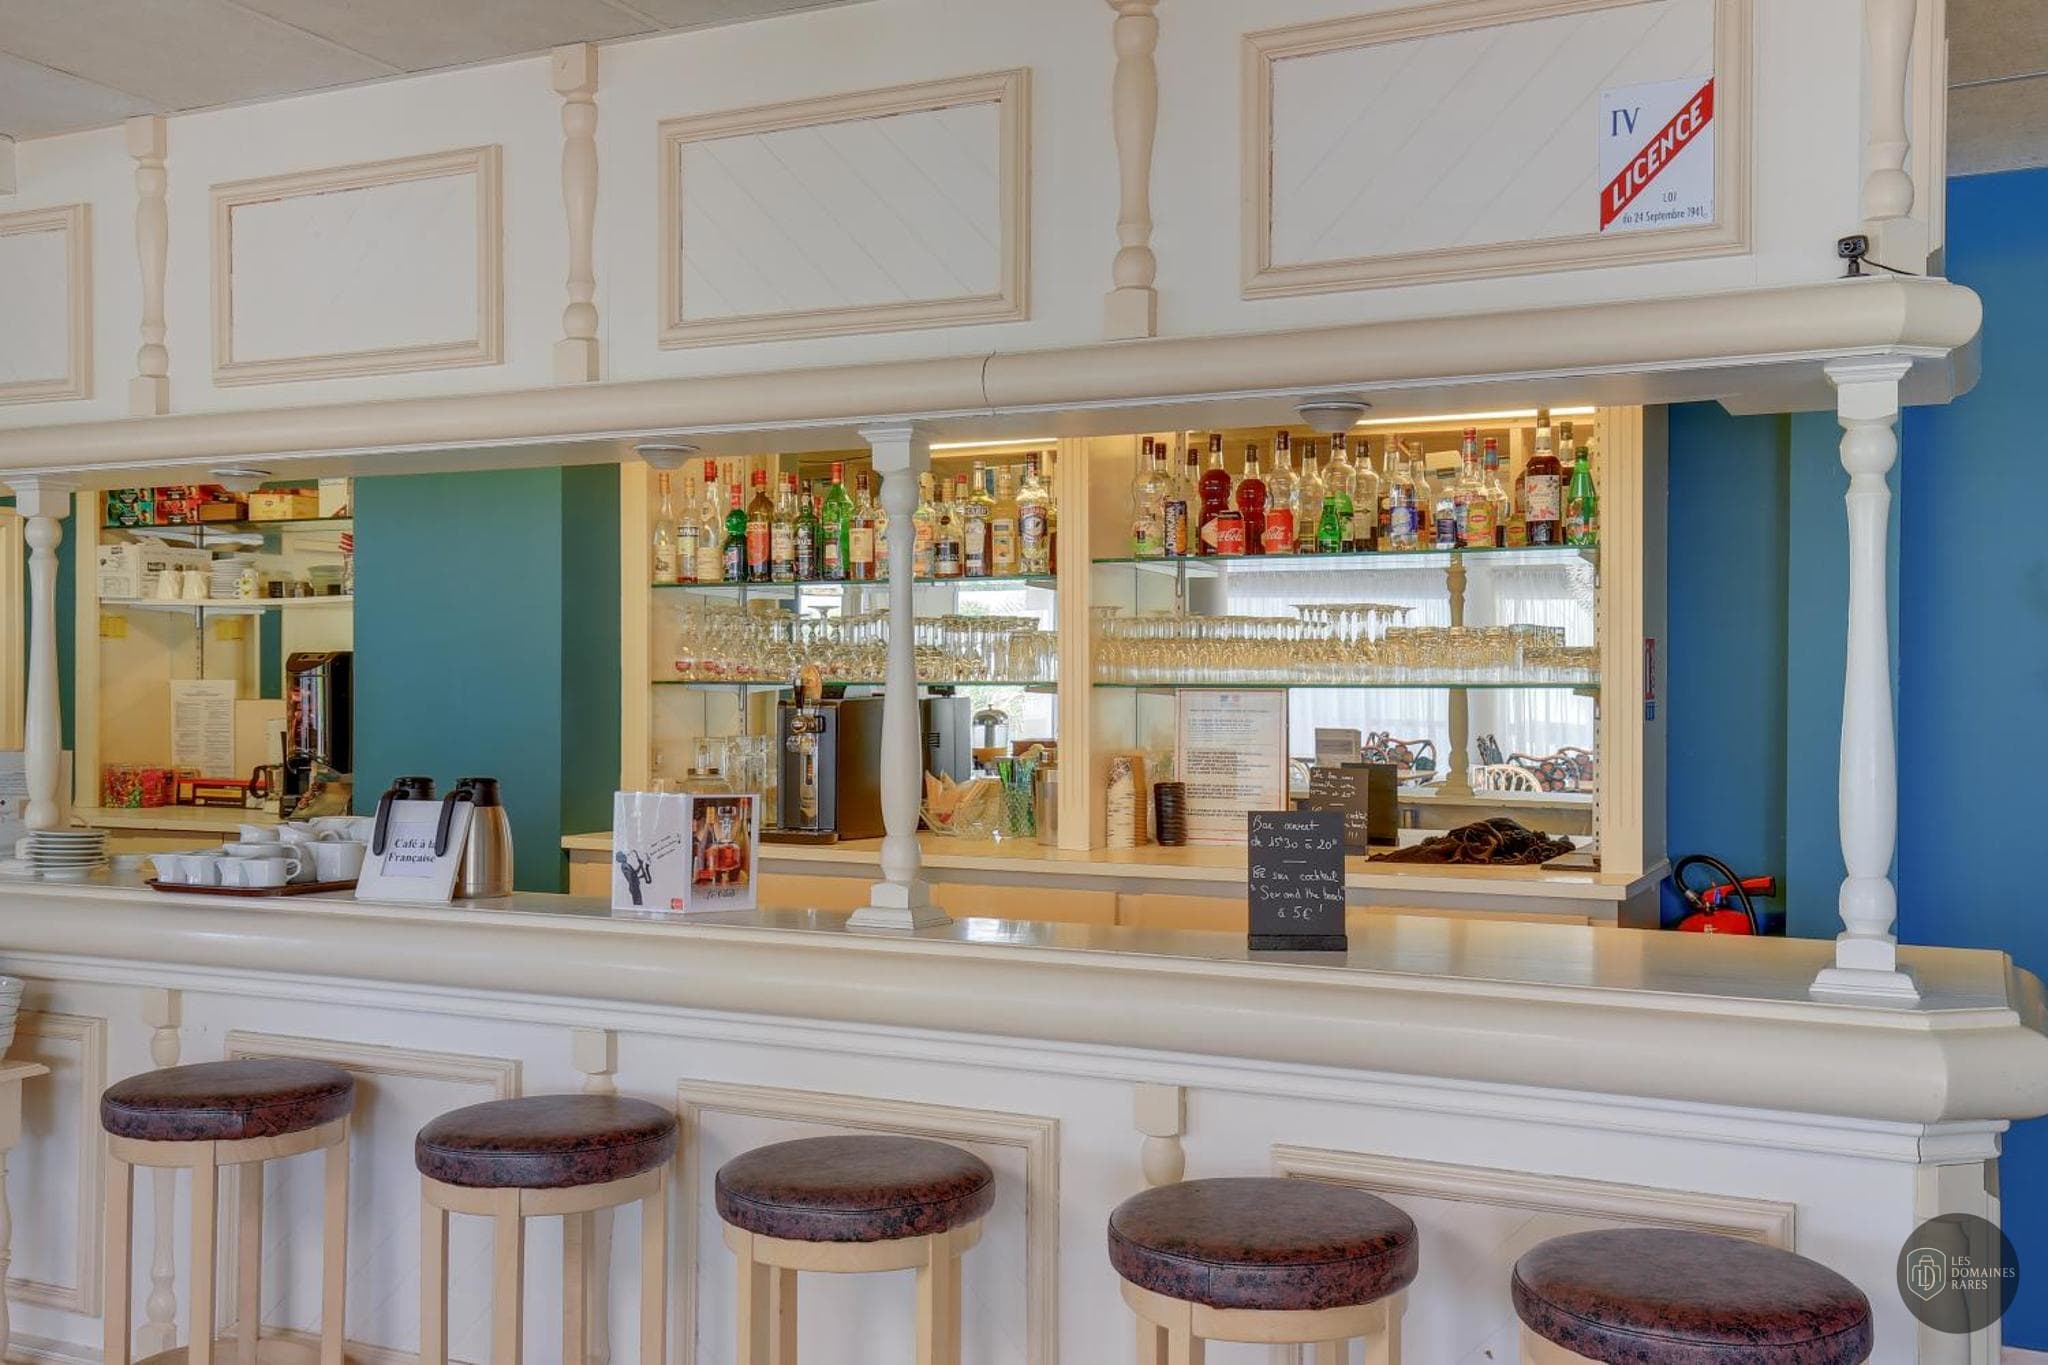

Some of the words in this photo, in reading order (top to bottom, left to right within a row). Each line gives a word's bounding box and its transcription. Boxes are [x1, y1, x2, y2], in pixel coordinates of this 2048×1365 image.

[1611, 107, 1640, 137] IV
[1612, 96, 1703, 211] LICENCE
[1645, 208, 1685, 224] Septembre
[394, 837, 418, 849] Café
[419, 838, 426, 849] à
[388, 851, 436, 865] Française
